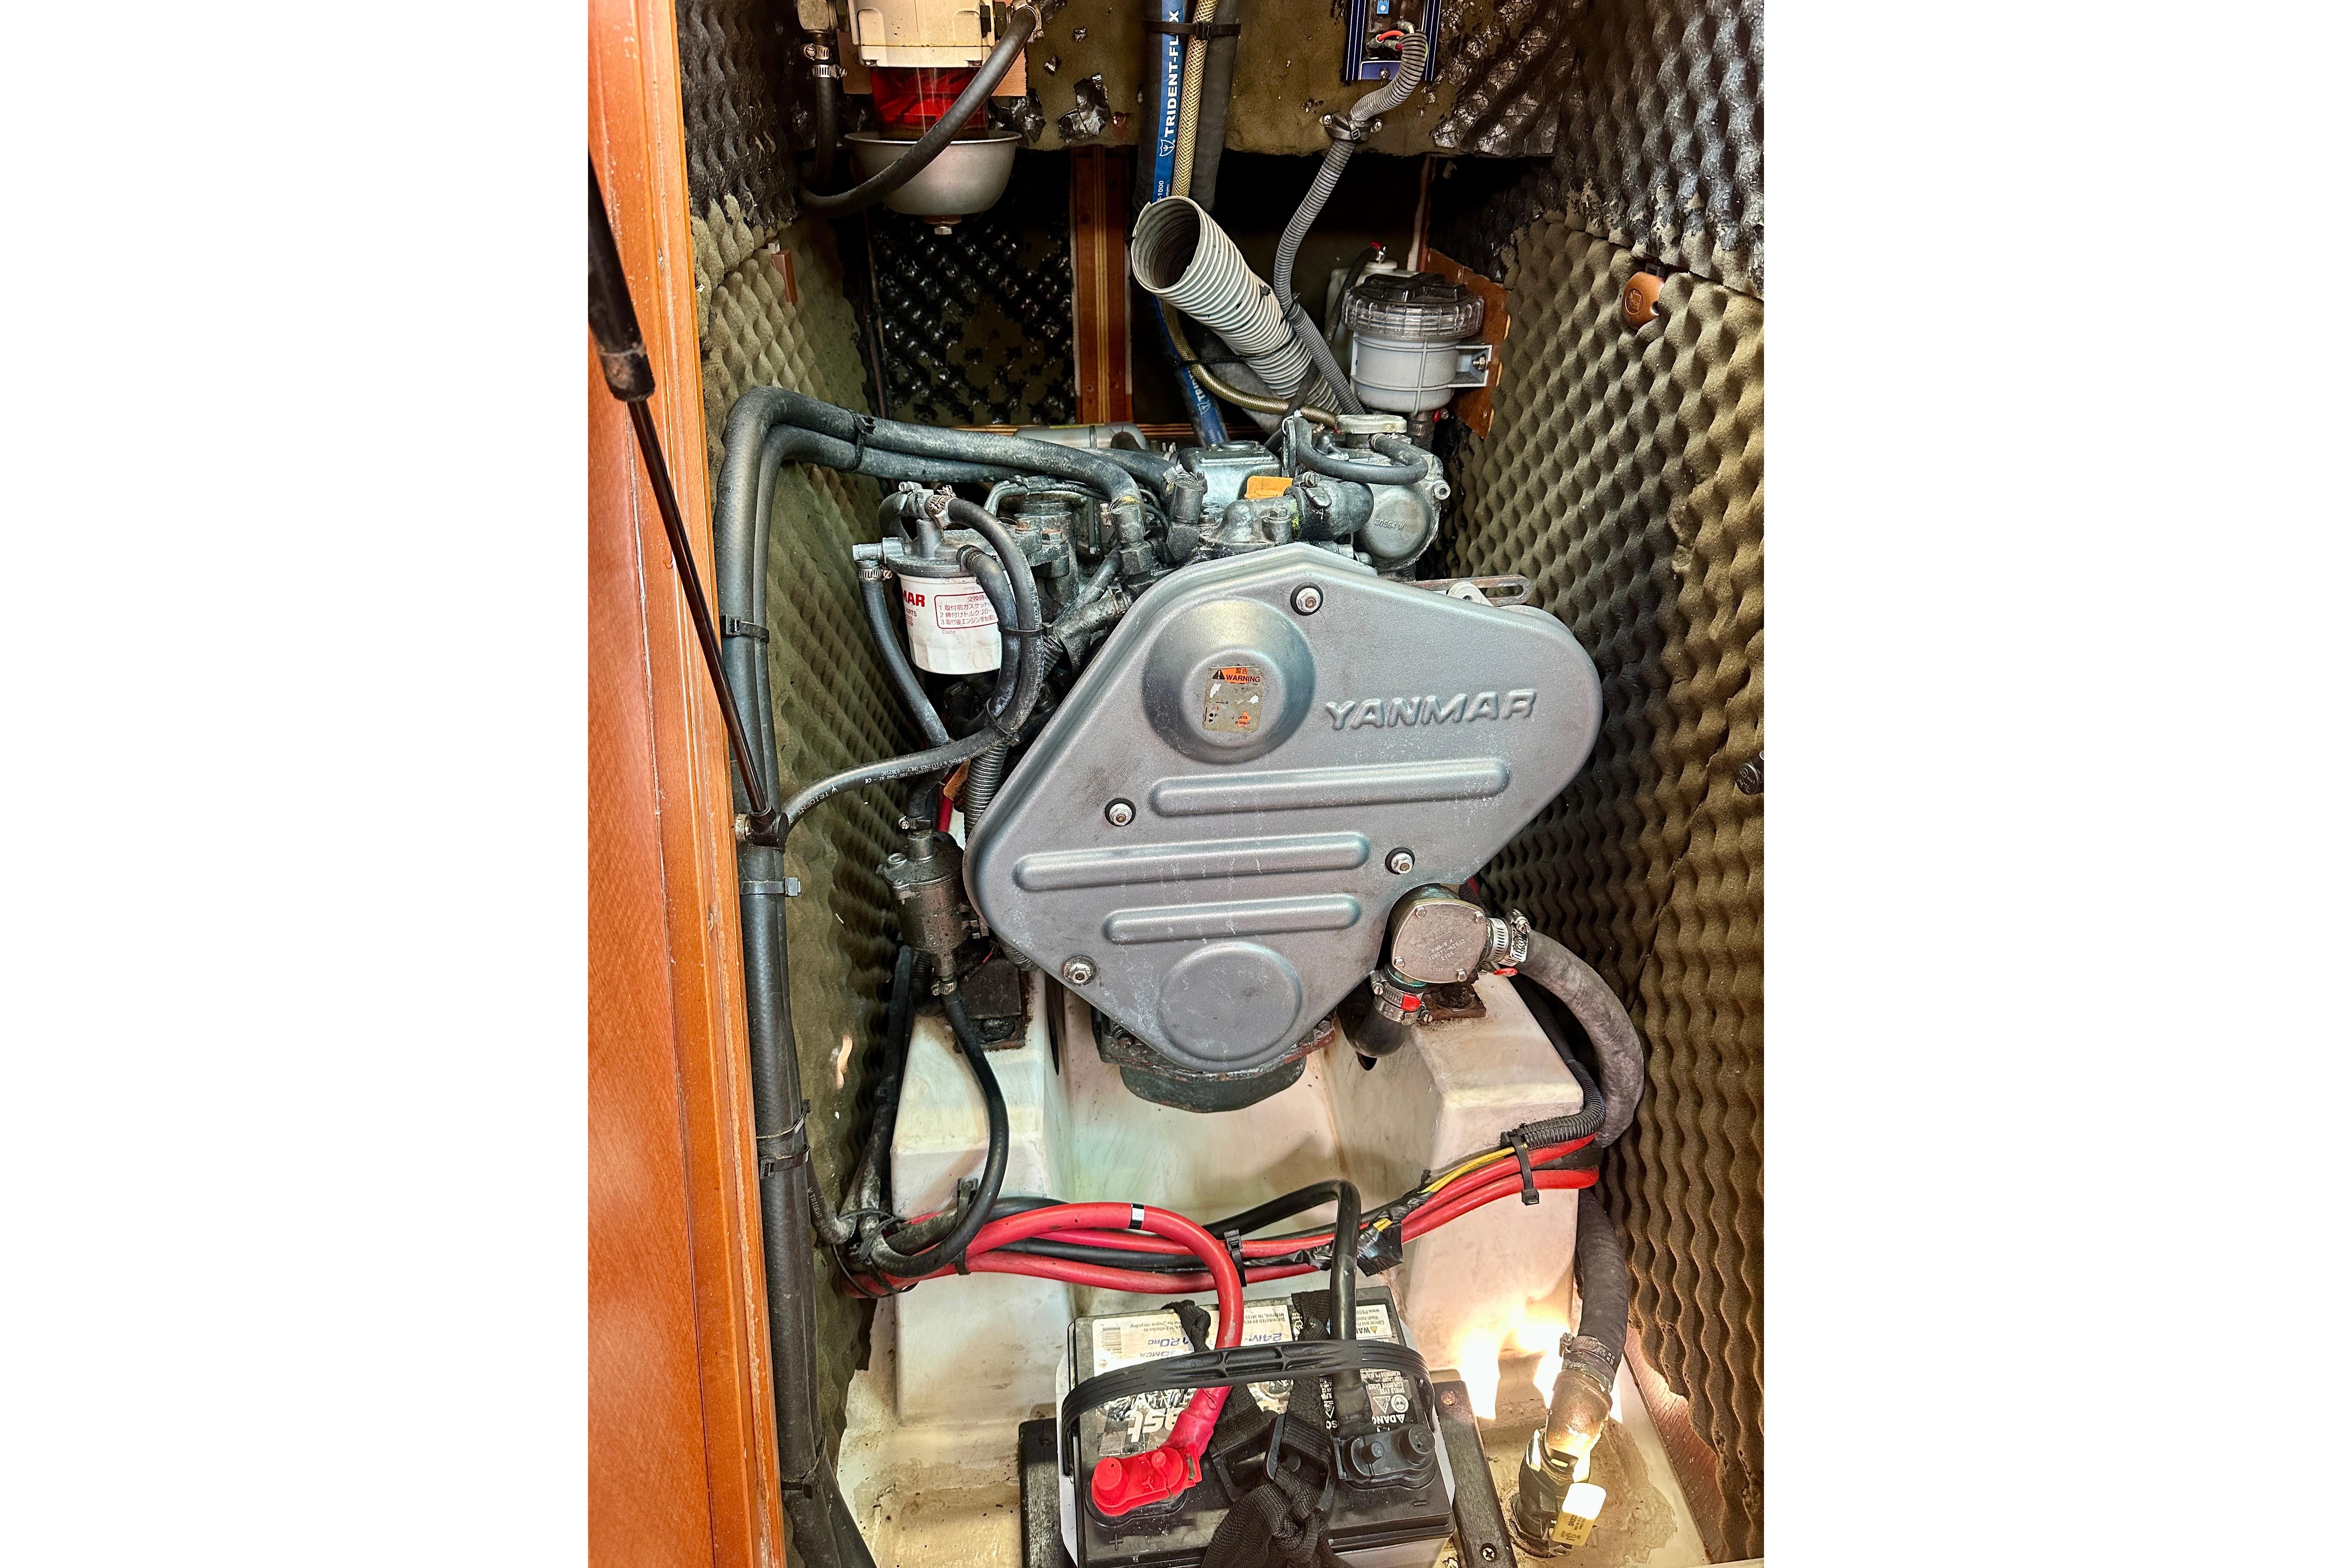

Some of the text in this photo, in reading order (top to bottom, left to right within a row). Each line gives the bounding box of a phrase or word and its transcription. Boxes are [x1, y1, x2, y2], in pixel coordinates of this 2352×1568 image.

[1164, 10, 1180, 138] TRIDENT-FLX
[902, 590, 925, 607] MAR
[1226, 674, 1260, 682] WARNING
[1325, 688, 1537, 731] YANMAR
[920, 762, 943, 770] FITTINGS
[797, 791, 830, 816] TRIDENT
[809, 1193, 823, 1218] TRIDENT
